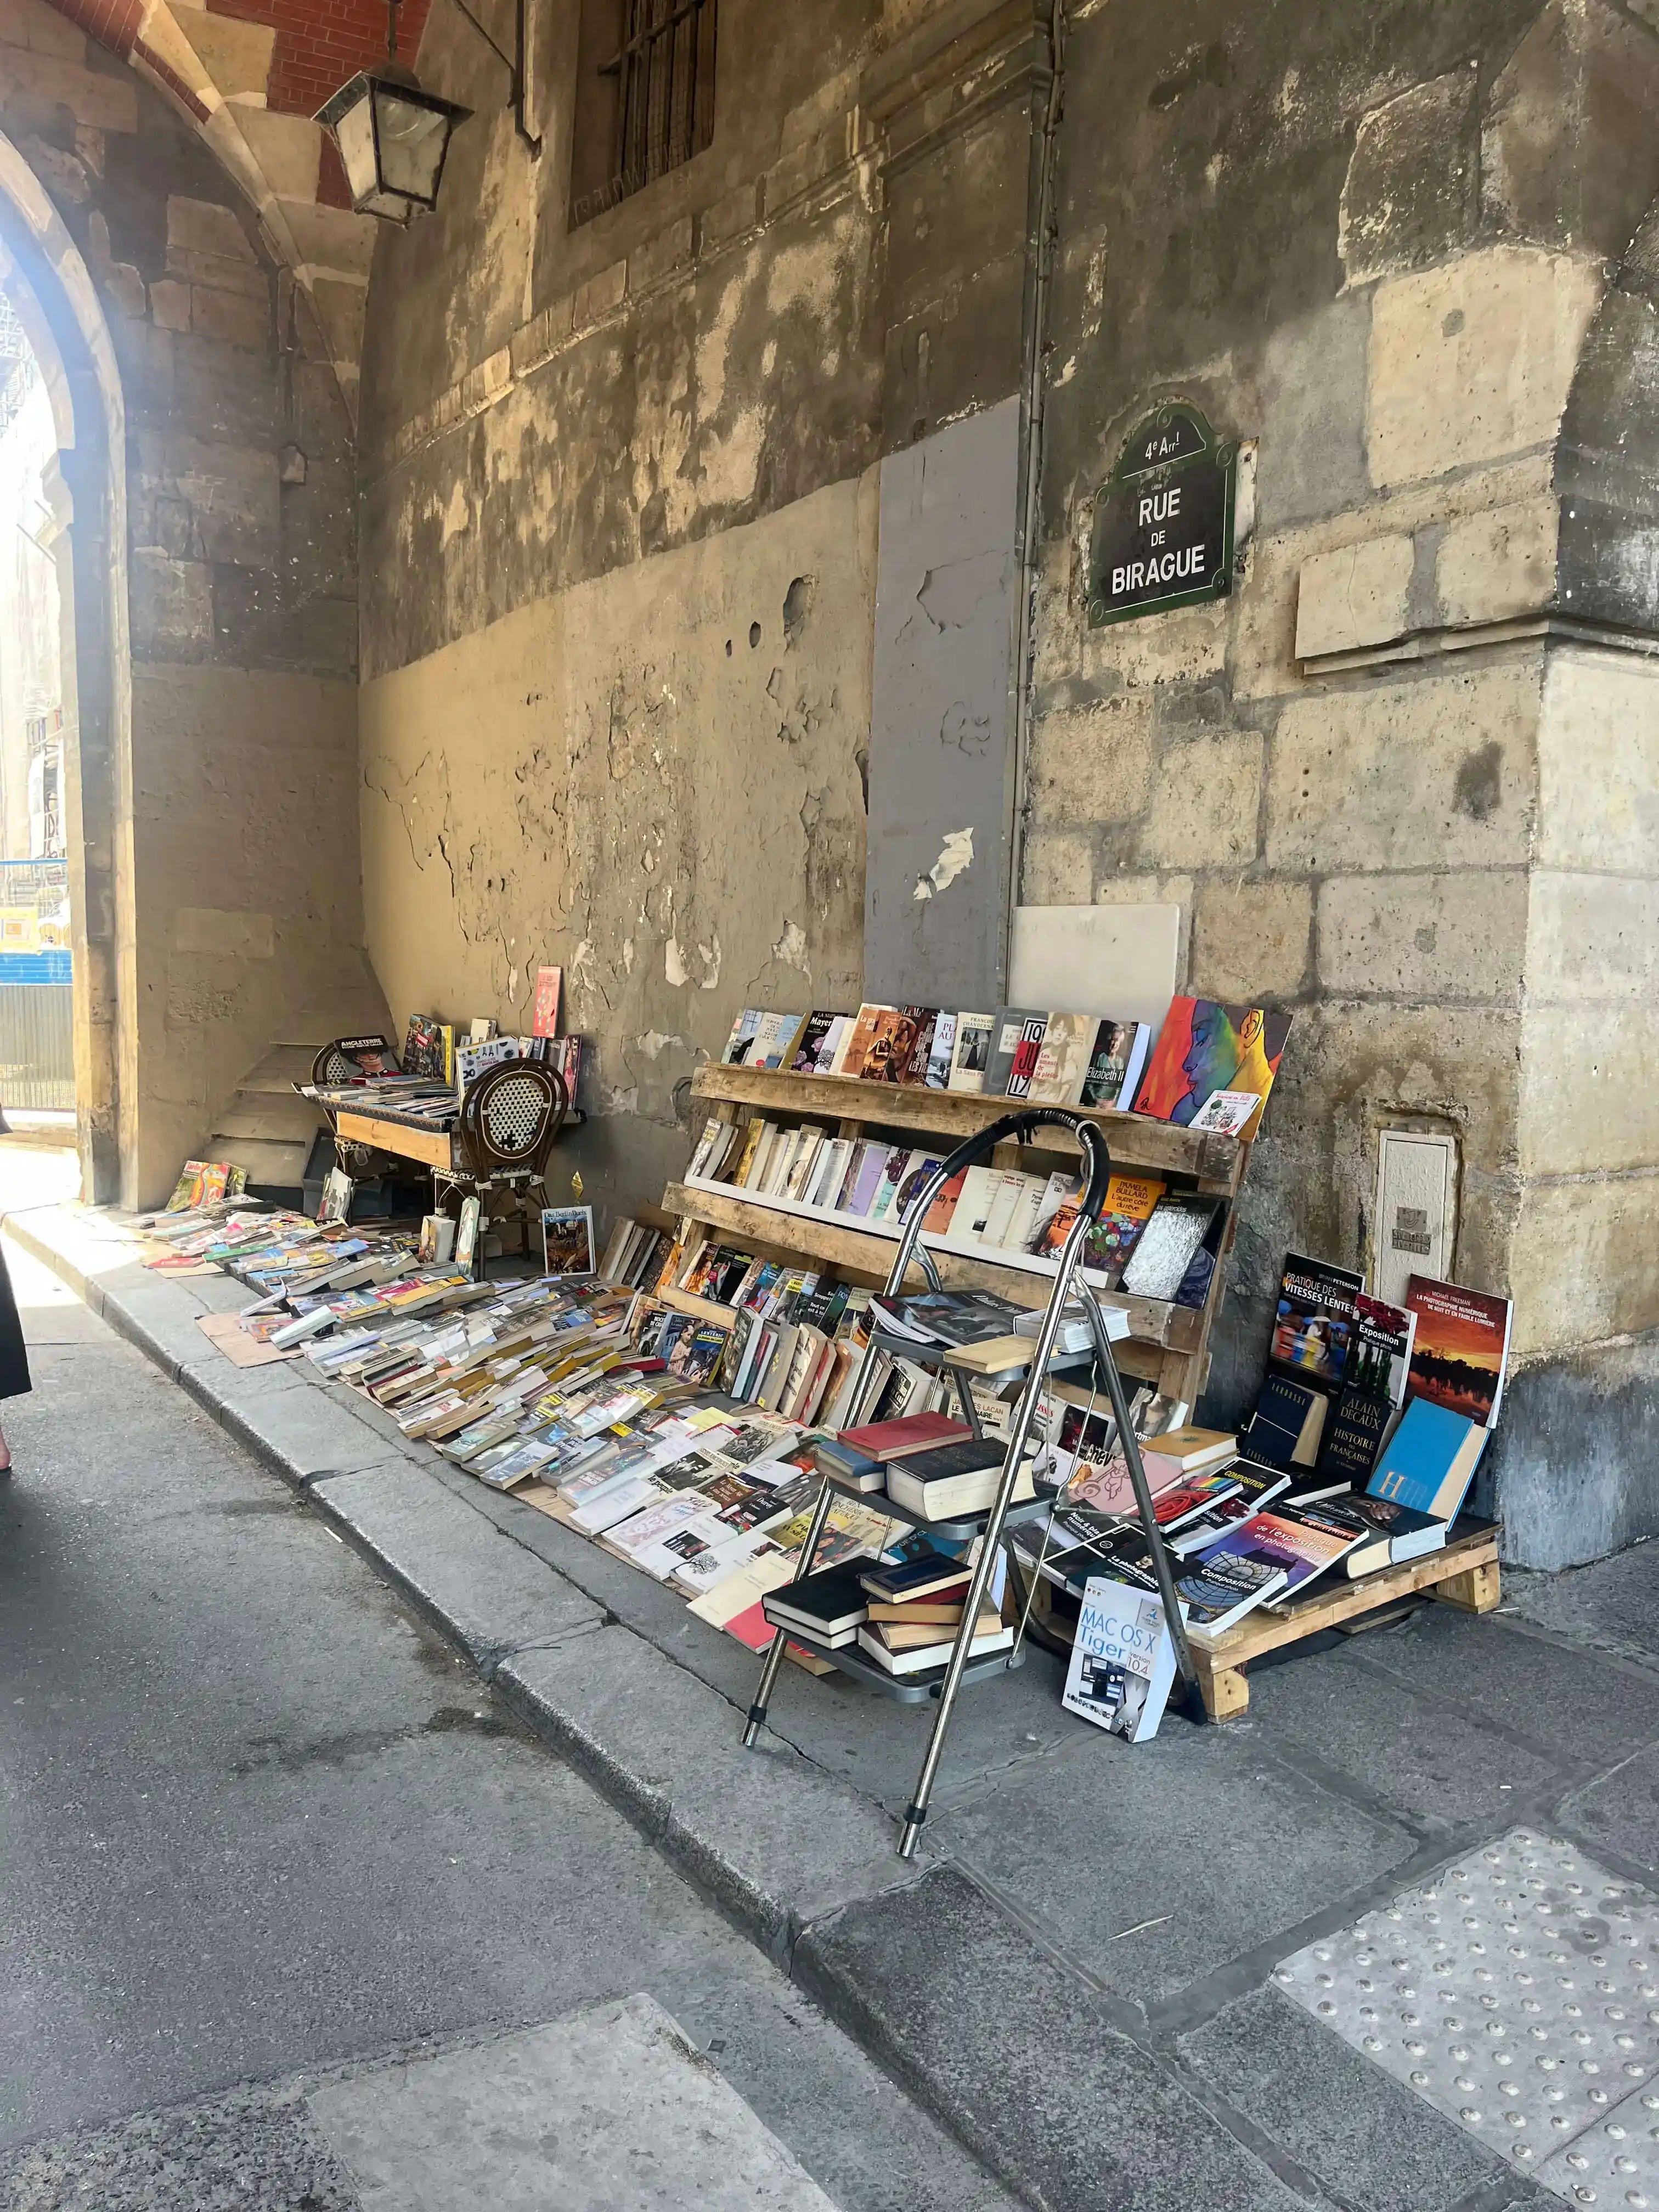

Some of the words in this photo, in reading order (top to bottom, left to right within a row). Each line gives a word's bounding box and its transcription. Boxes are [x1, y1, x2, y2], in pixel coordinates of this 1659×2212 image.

[1139, 488, 1181, 526] RUE
[1150, 530, 1166, 546] DE
[1112, 544, 1205, 595] BIRAGUE
[810, 1017, 833, 1027] Mayer
[341, 1038, 382, 1047] ANGLETERRE
[1087, 1067, 1117, 1081] Elizabeth
[1118, 1071, 1124, 1082] II
[1116, 1187, 1148, 1199] BULLARD
[1119, 1181, 1147, 1192] PAMELA
[1111, 1193, 1133, 1203] L'autre
[1286, 1272, 1321, 1292] PRATIQUE
[1322, 1284, 1336, 1297] DES
[1333, 1278, 1359, 1291] PETERSON
[1285, 1283, 1322, 1303] VITESSES
[1324, 1296, 1356, 1314] LENTES
[1423, 1296, 1458, 1311] PHOTOGRAPHIE
[1432, 1291, 1449, 1300] MICHAEL
[1450, 1296, 1471, 1306] FREEMAN
[1359, 1324, 1398, 1346] Exposition
[1363, 1336, 1380, 1346] Pratique
[983, 1404, 1003, 1415] LACAN
[1347, 1397, 1381, 1418] ALAIN
[1340, 1406, 1381, 1430] DECAUX
[1334, 1427, 1376, 1451] HISTOIRE
[1330, 1443, 1371, 1465] FRANÇAISES
[1224, 1470, 1266, 1489] COMPOSITION
[1071, 1512, 1085, 1522] Noir
[1268, 1527, 1330, 1555] l'exposition
[1299, 1530, 1339, 1548] Pratique
[1265, 1537, 1322, 1562] photographie
[1119, 1560, 1159, 1586] photographie
[1201, 1568, 1256, 1590] Composition
[1081, 1606, 1118, 1637] MAC
[1121, 1624, 1143, 1647] OS
[1148, 1635, 1156, 1654] X
[1080, 1623, 1127, 1659] Tiger
[1127, 1657, 1148, 1675] 10.4
[1130, 1652, 1151, 1664] version
